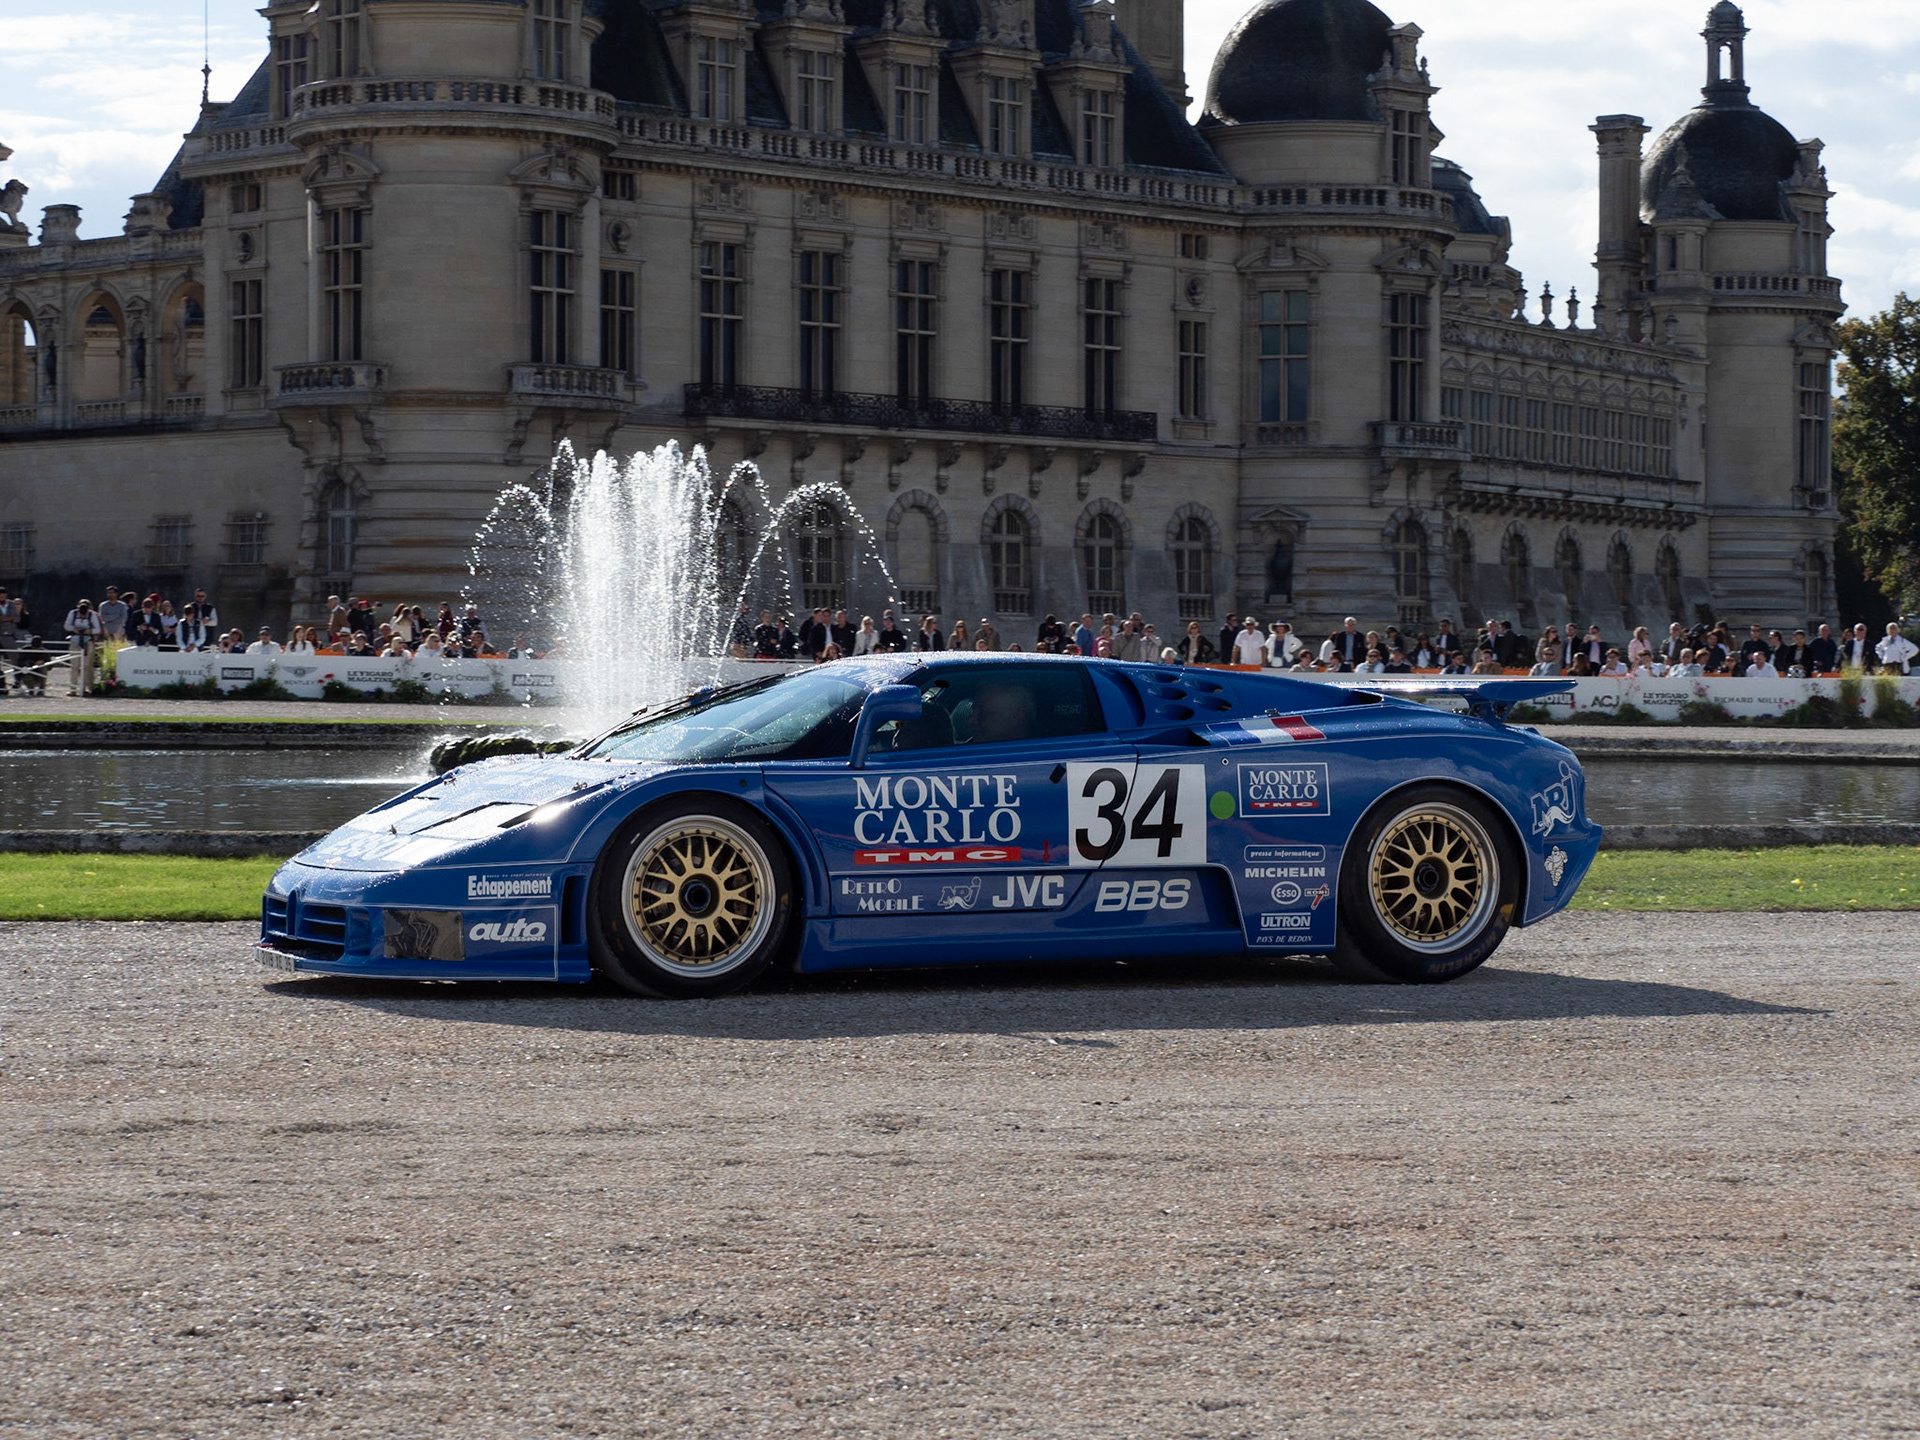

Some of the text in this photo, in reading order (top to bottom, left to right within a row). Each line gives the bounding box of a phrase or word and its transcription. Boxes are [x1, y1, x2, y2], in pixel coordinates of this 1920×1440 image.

[1590, 695, 1620, 707] ACJ
[1248, 770, 1318, 785] MONTE
[853, 774, 1020, 809] MONTE
[1248, 784, 1318, 800] CARLO
[1075, 767, 1183, 861] 34
[853, 808, 1021, 845] CARLO
[863, 850, 1008, 862] TMC
[1245, 867, 1326, 878] MICHELIN
[468, 874, 552, 898] Echappement
[992, 875, 1064, 908] JVC
[1094, 878, 1191, 912] BBS
[469, 918, 547, 941] auto
[1260, 916, 1311, 928] ULTRON
